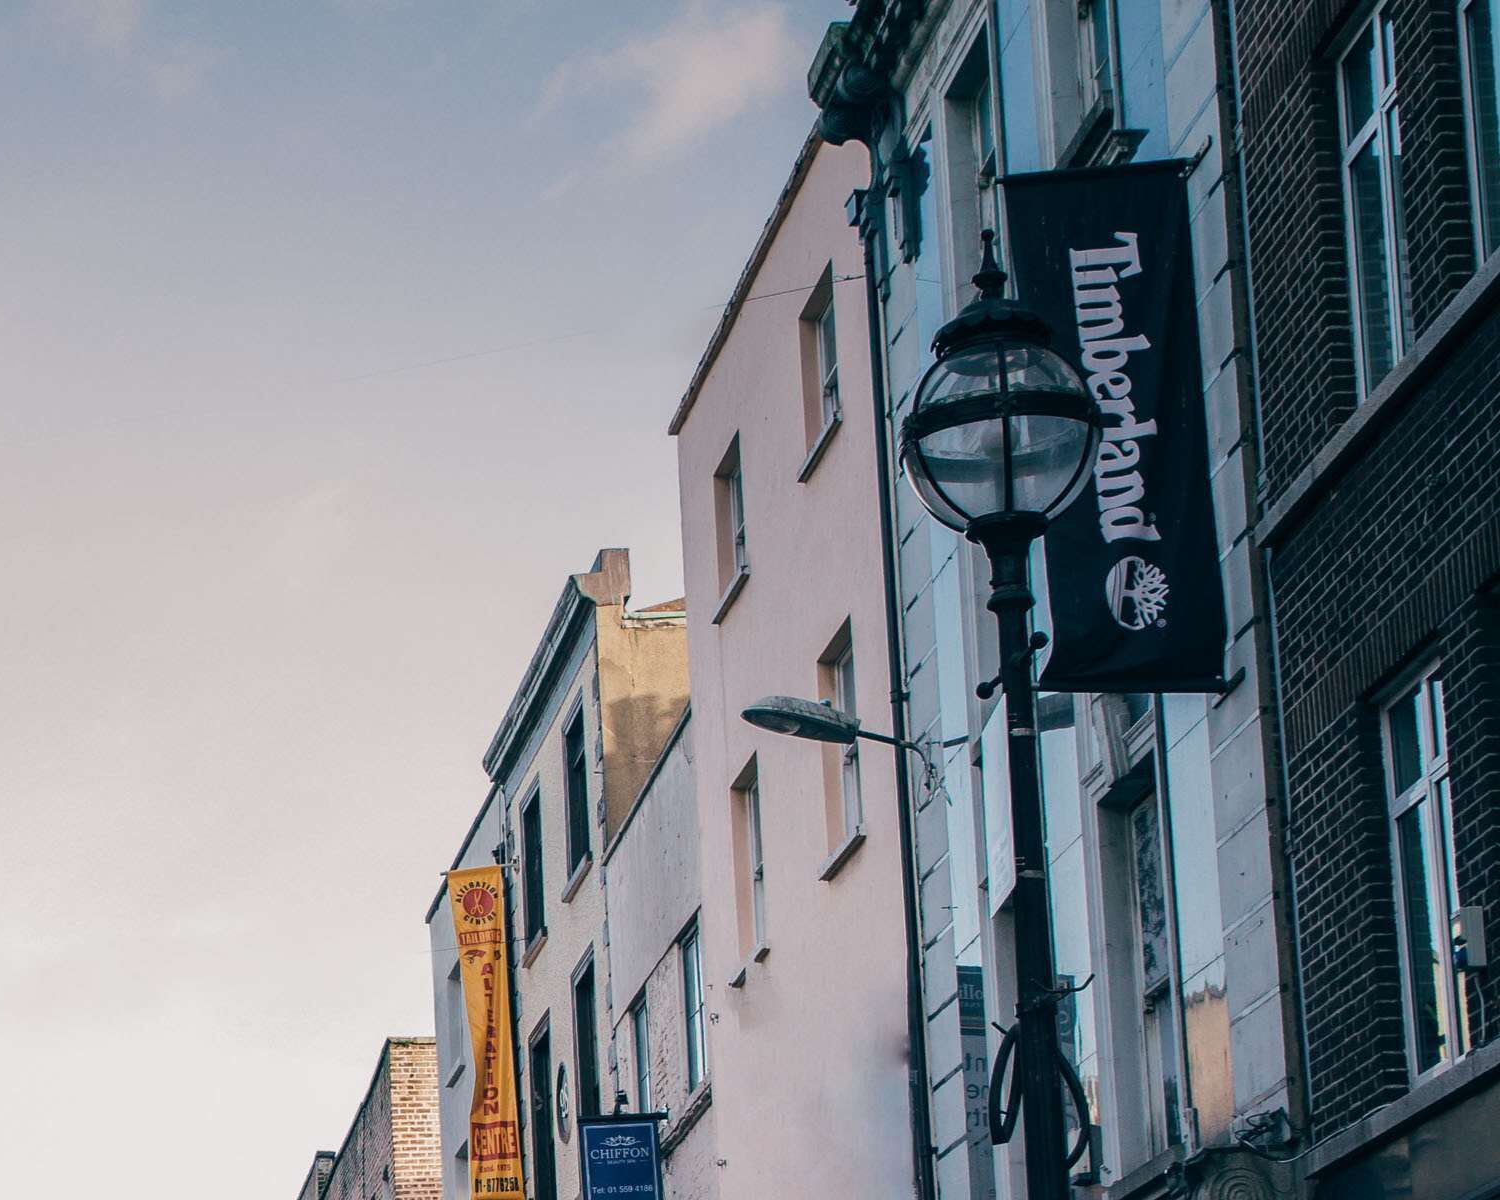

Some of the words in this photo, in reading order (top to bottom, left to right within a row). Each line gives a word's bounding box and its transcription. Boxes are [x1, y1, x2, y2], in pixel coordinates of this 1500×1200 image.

[1069, 231, 1161, 543] Timberland
[481, 963, 499, 1116] ALTERATION
[475, 1126, 516, 1156] CENTRE
[591, 1147, 649, 1159] CHIFFON
